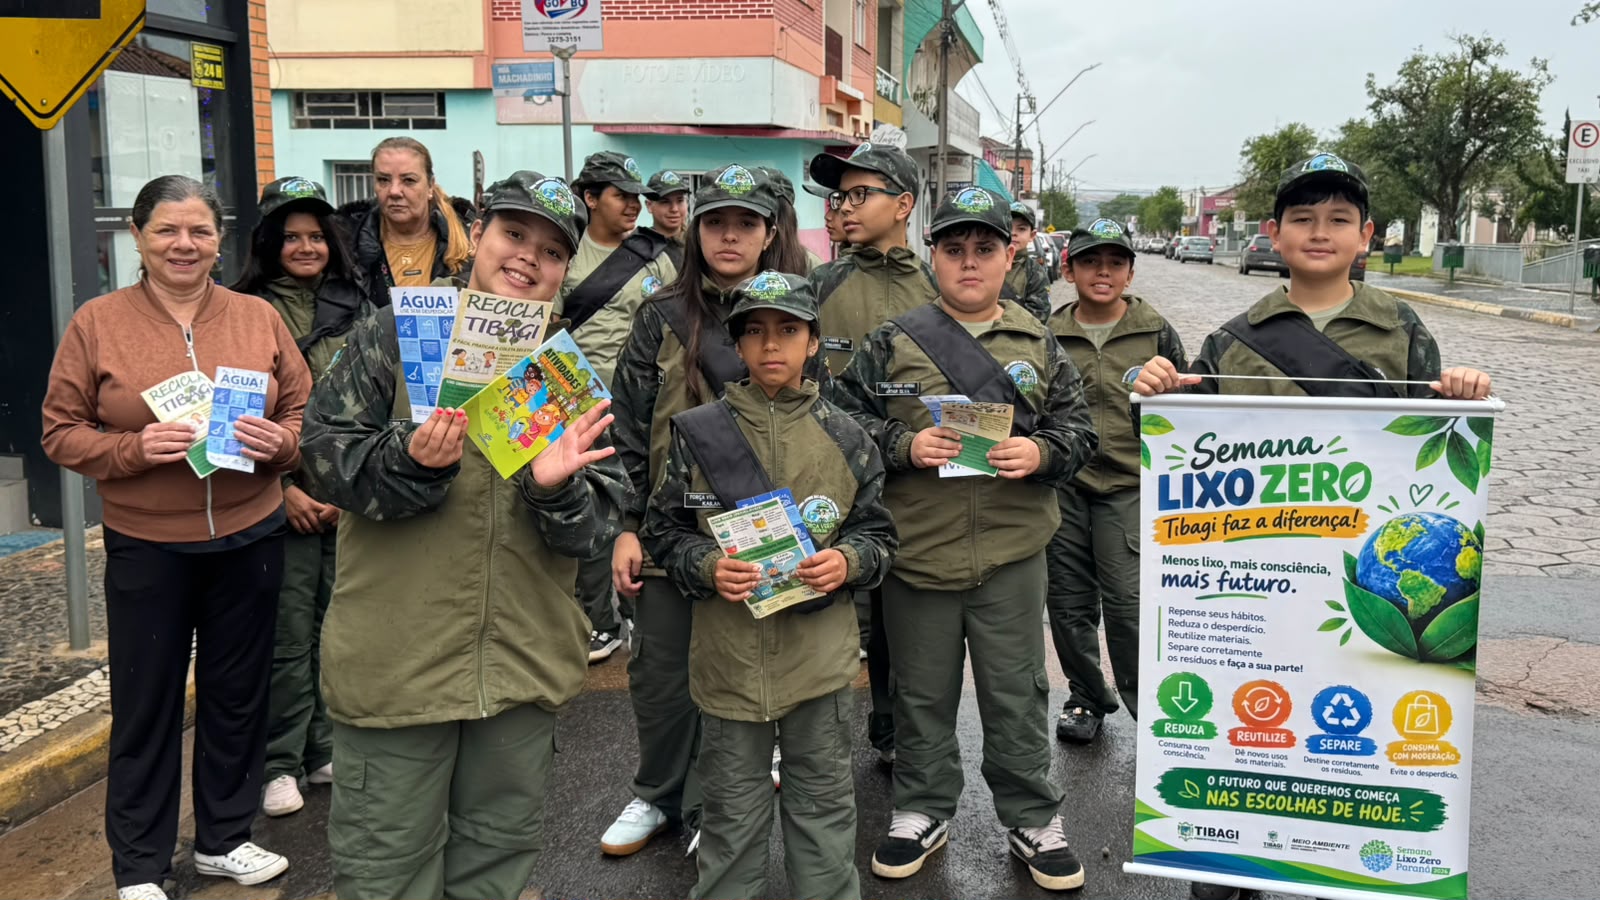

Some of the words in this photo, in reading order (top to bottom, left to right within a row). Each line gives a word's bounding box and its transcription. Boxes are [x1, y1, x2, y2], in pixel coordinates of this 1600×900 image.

[204, 62, 215, 78] 24
[498, 72, 553, 84] MACHADINHO
[623, 63, 669, 83] FOTO
[1581, 128, 1592, 143] E
[399, 290, 454, 309] ÁGUA!
[466, 293, 545, 320] RECICLA
[464, 315, 541, 342] TIBAGI
[544, 347, 582, 390] ATIVIDADES
[149, 372, 205, 402] RECICLA
[1190, 431, 1324, 471] Semana
[1157, 467, 1255, 511] LIXO
[1259, 461, 1373, 504] ZERO
[1162, 515, 1217, 541] Tibagi
[1222, 512, 1251, 535] faz
[1255, 516, 1268, 530] a
[1271, 508, 1360, 532] diferença!
[1161, 554, 1200, 567] Menos
[1202, 556, 1228, 570] lixo,
[1230, 559, 1258, 571] mais
[1260, 561, 1332, 577] consciência,
[1161, 570, 1210, 590] mais
[1216, 569, 1298, 594] futuro.
[1168, 606, 1207, 618] Repense
[1208, 609, 1230, 619] seus
[1231, 610, 1267, 623] hábitos.
[1168, 618, 1201, 630] Reduza
[1202, 622, 1209, 630] o
[1210, 620, 1266, 636] desperdício.
[1167, 630, 1207, 642] Reutilize
[1208, 633, 1253, 646] materiais.
[1167, 641, 1200, 654] Separe
[1201, 644, 1263, 659] corretamente
[1167, 654, 1178, 662] os
[1180, 653, 1218, 666] resíduos
[1219, 658, 1226, 666] e
[1227, 658, 1246, 670] faça
[1248, 661, 1254, 669] a
[1256, 661, 1272, 671] sua
[1274, 662, 1304, 674] parte!
[1164, 722, 1205, 735] REDUZA
[1236, 730, 1288, 743] REUTILIZE
[1158, 739, 1193, 750] Consuma
[1194, 744, 1210, 752] com
[1319, 738, 1362, 751] SEPARE
[1402, 743, 1440, 751] CONSUMA
[1163, 748, 1207, 760] consciência.
[1234, 748, 1246, 757] Dê
[1247, 750, 1270, 760] novos
[1271, 753, 1289, 761] usos
[1392, 752, 1409, 761] COM
[1410, 752, 1456, 762] MODERAÇÃO
[1234, 757, 1248, 765] aos
[1249, 758, 1287, 769] materiais.
[1303, 755, 1330, 766] Destine
[1331, 759, 1380, 771] corretamente
[1331, 766, 1363, 777] resíduos.
[1389, 767, 1409, 776] Evite
[1409, 769, 1415, 777] o
[1416, 769, 1460, 780] desperdício.
[1206, 775, 1216, 786] O
[1218, 775, 1261, 790] FUTURO
[1264, 779, 1288, 792] QUE
[1291, 782, 1351, 799] QUEREMOS
[1354, 788, 1401, 804] COMEÇA
[1206, 790, 1240, 807] NAS
[1245, 793, 1328, 816] ESCOLHAS
[1332, 800, 1354, 818] DE
[1358, 803, 1407, 824] HOJE.
[1194, 825, 1240, 841] TIBAGI
[1263, 841, 1284, 850] TIBAGI
[1291, 838, 1312, 846] MEIO
[1311, 840, 1351, 850] AMBIENTE
[1396, 845, 1433, 856] Semana
[1396, 854, 1418, 864] Lixo
[1419, 856, 1442, 866] Zero
[1395, 863, 1431, 874] Paraná
